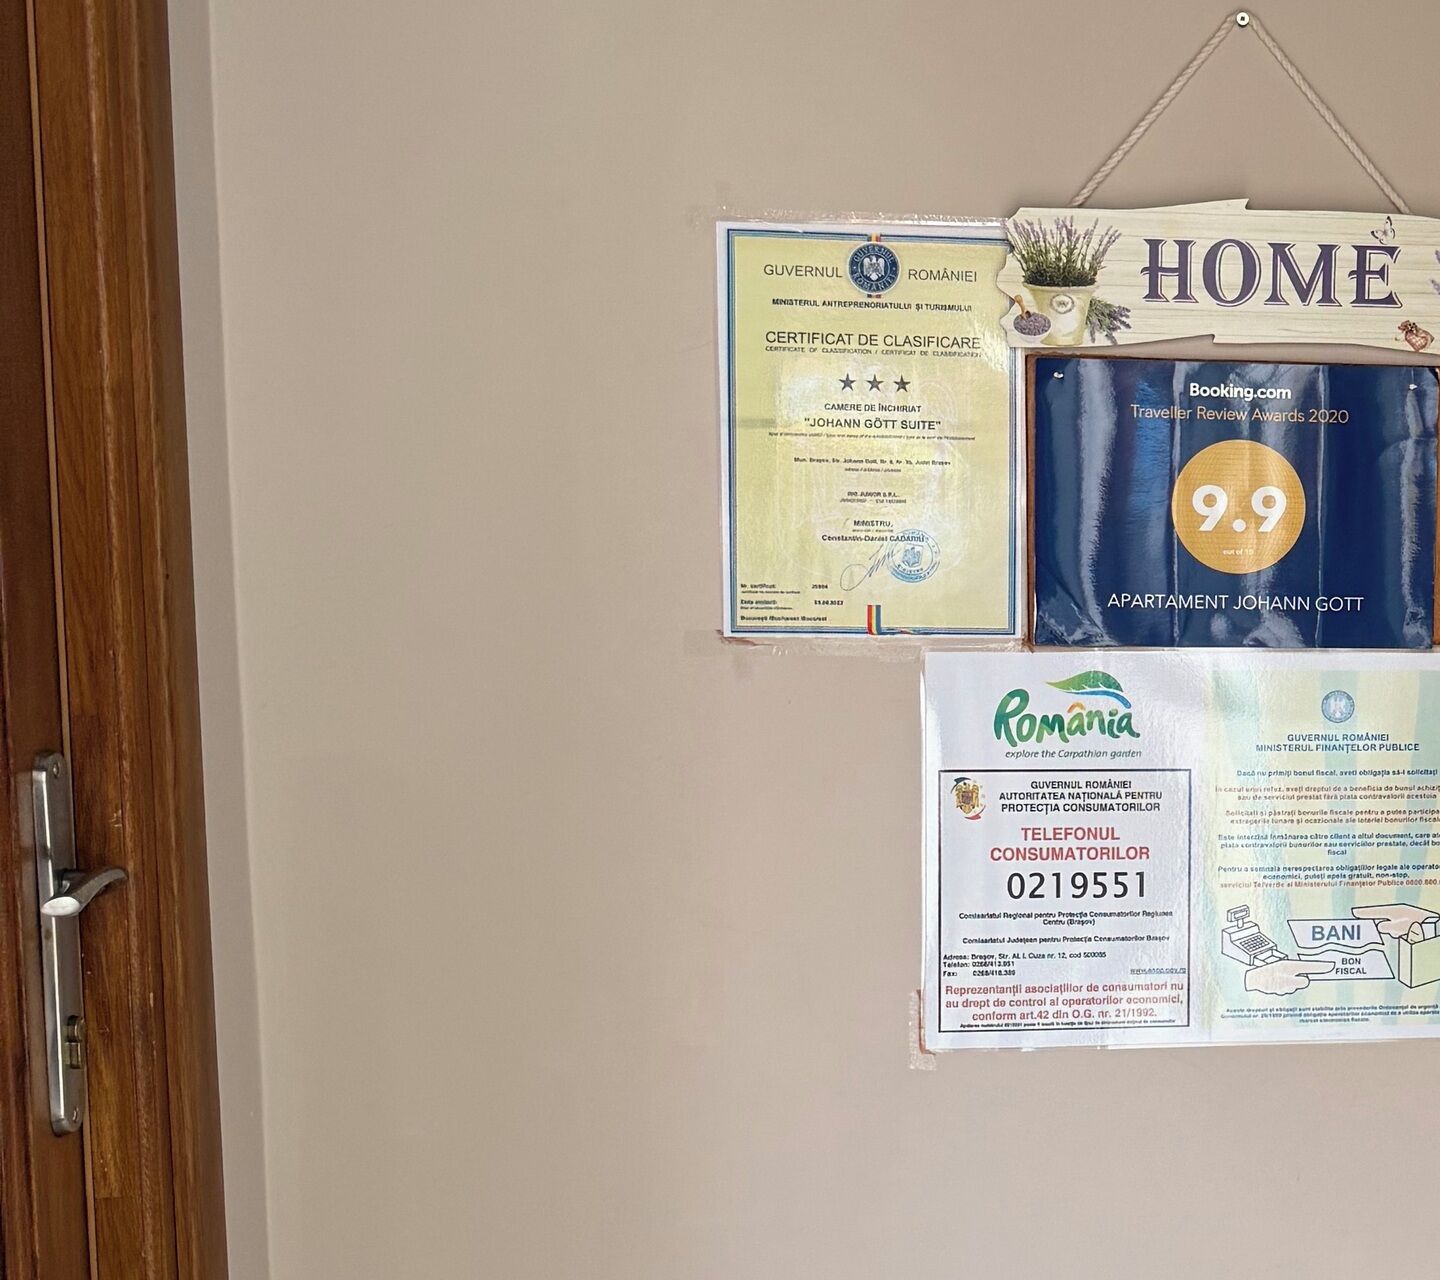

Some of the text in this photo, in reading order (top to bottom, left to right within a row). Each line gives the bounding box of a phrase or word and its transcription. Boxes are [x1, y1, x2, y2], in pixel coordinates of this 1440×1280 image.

[764, 265, 977, 282] GUVERNUL ROMÂNIEI
[1141, 239, 1402, 308] HOME
[772, 299, 819, 307] MINISTERUL
[822, 300, 912, 309] ANTREPRENORIATULUI
[766, 332, 980, 349] CERTIFICAT DE CLASIFICARE
[1190, 382, 1291, 401] Booking.com
[825, 403, 862, 411] CAMERE
[878, 404, 921, 412] ÎNCHIRIAT
[1130, 404, 1348, 423] Traveller Review Awards 2020
[805, 418, 861, 428] "JOHANN
[901, 420, 940, 429] SUITE"
[1191, 485, 1287, 532] 9.9
[1107, 593, 1364, 611] APARTAMENT JOHANN GOTT
[994, 689, 1140, 747] România
[1287, 732, 1389, 742] GUVERNUL ROMÂNIEI
[1256, 744, 1313, 752] MINISTERUL
[1379, 743, 1420, 751] PUBLICE
[1006, 749, 1141, 759] explore the Carpathian garden
[1031, 779, 1131, 789] GUVERNUL ROMÂNIEI
[999, 792, 1065, 800] AUTORITATEA
[1063, 803, 1160, 812] CONSUMATORILOR
[1021, 827, 1120, 841] TELEFONUL
[990, 846, 1150, 861] CONSUMATORILOR
[1327, 848, 1346, 856] fiscal
[1007, 871, 1145, 899] 0219551
[1089, 910, 1140, 918] Consumatorilor
[1312, 925, 1361, 941] BANI
[1039, 936, 1061, 944] pentru
[1336, 967, 1367, 975] FISCAL
[1087, 983, 1099, 992] de
[1102, 982, 1167, 992] consumatori
[1171, 983, 1184, 991] nu
[946, 994, 1183, 1009] au drept de control al operatorilor economici,
[972, 1008, 1157, 1021] conform art.42 din O.G. nr. 21/1992.
